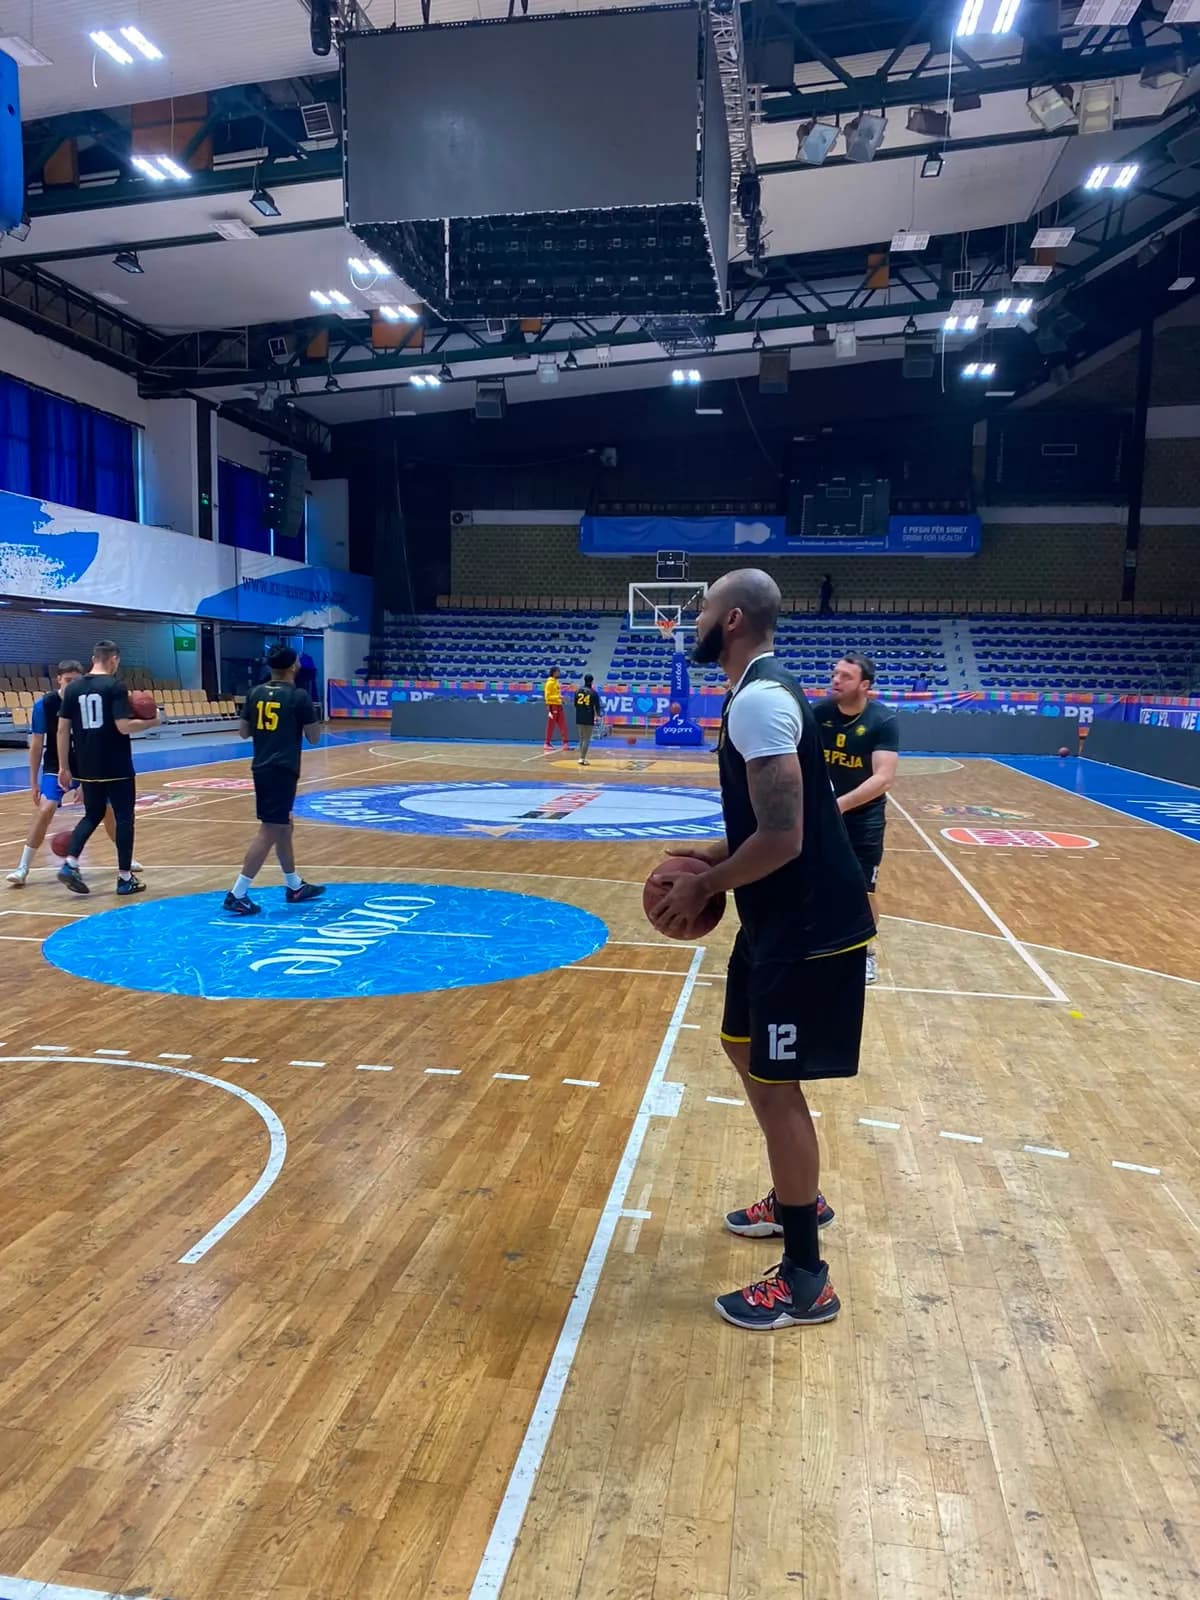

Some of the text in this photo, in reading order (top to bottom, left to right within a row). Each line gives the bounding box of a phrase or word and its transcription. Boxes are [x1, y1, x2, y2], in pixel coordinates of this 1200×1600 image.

[356, 690, 389, 706] WE
[577, 693, 591, 706] 24
[600, 696, 634, 712] WE
[78, 693, 104, 729] 10
[256, 701, 281, 731] 15
[1064, 706, 1094, 723] PR
[767, 1023, 798, 1061] 12
